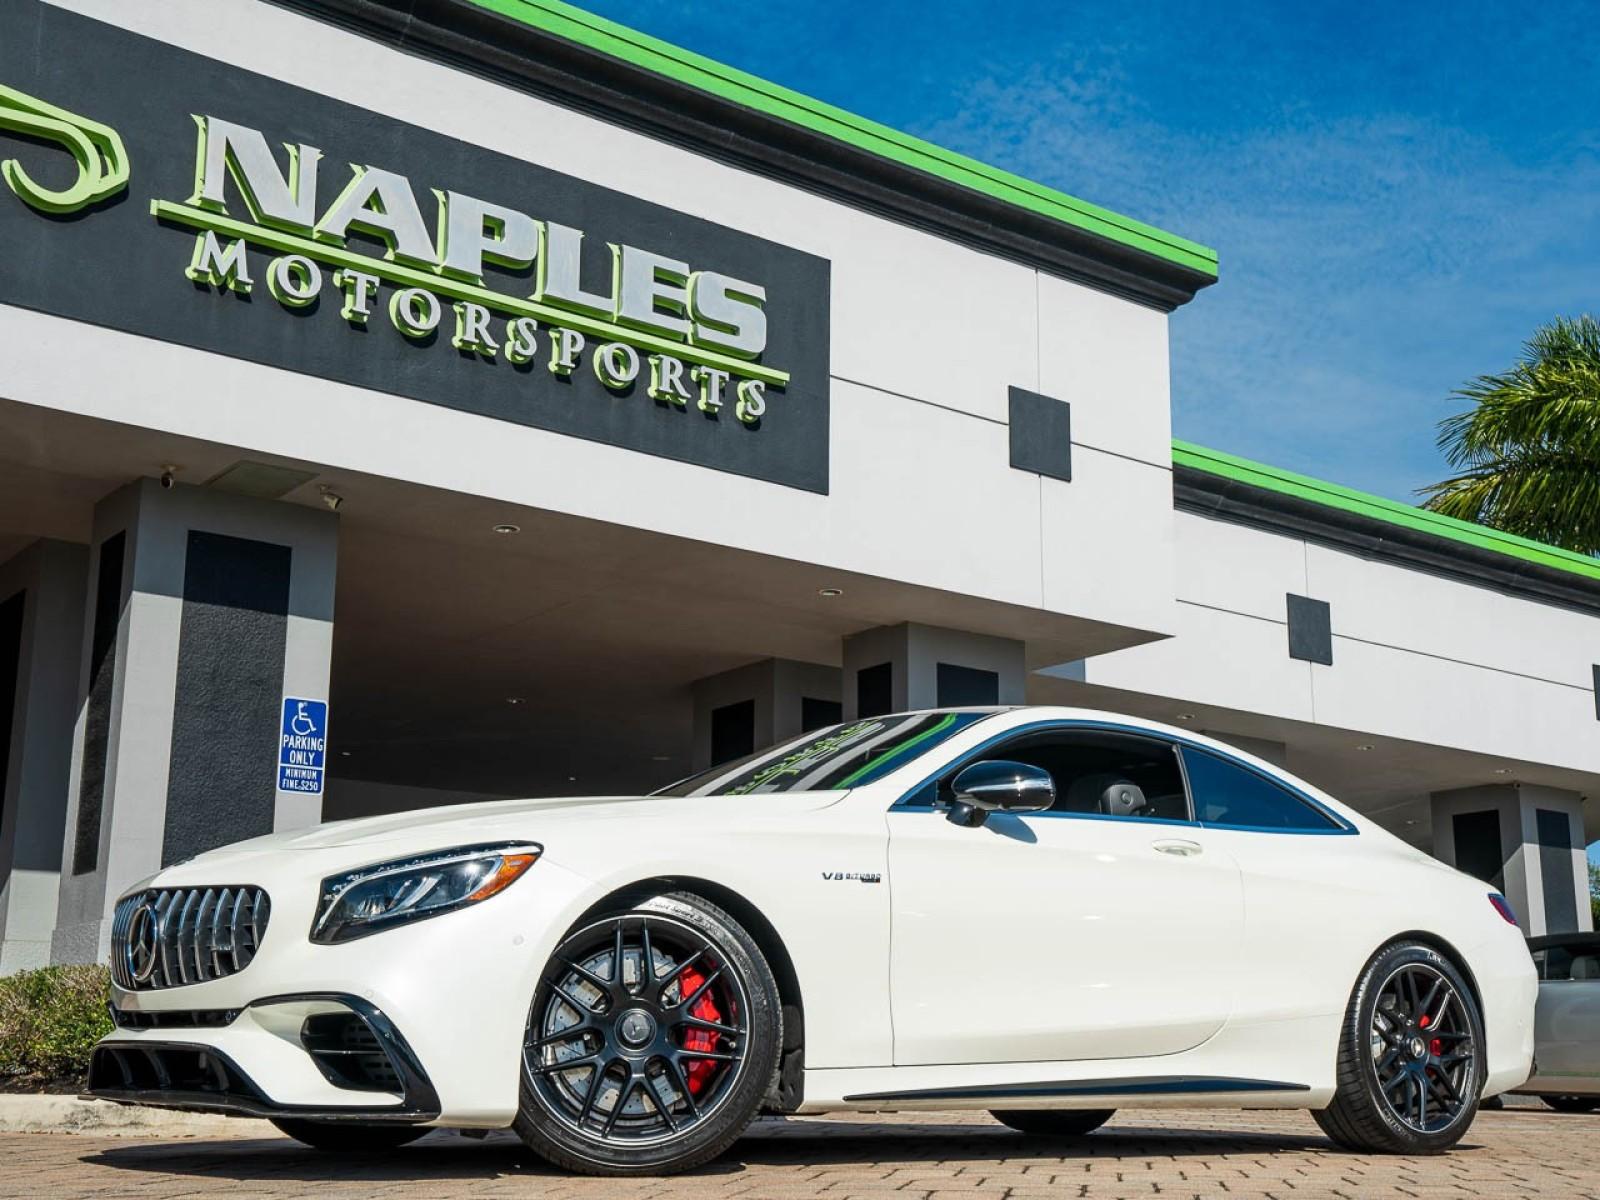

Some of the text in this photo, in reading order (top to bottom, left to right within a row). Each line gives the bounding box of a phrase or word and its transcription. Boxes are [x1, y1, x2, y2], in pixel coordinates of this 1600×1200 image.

[191, 113, 768, 360] NAPLES
[185, 230, 767, 424] MOTORSPORTS
[283, 734, 324, 752] PARKING
[289, 750, 316, 766] ONLY
[285, 768, 318, 780] MINIMUM
[282, 779, 300, 790] FINE
[821, 872, 844, 881] V8
